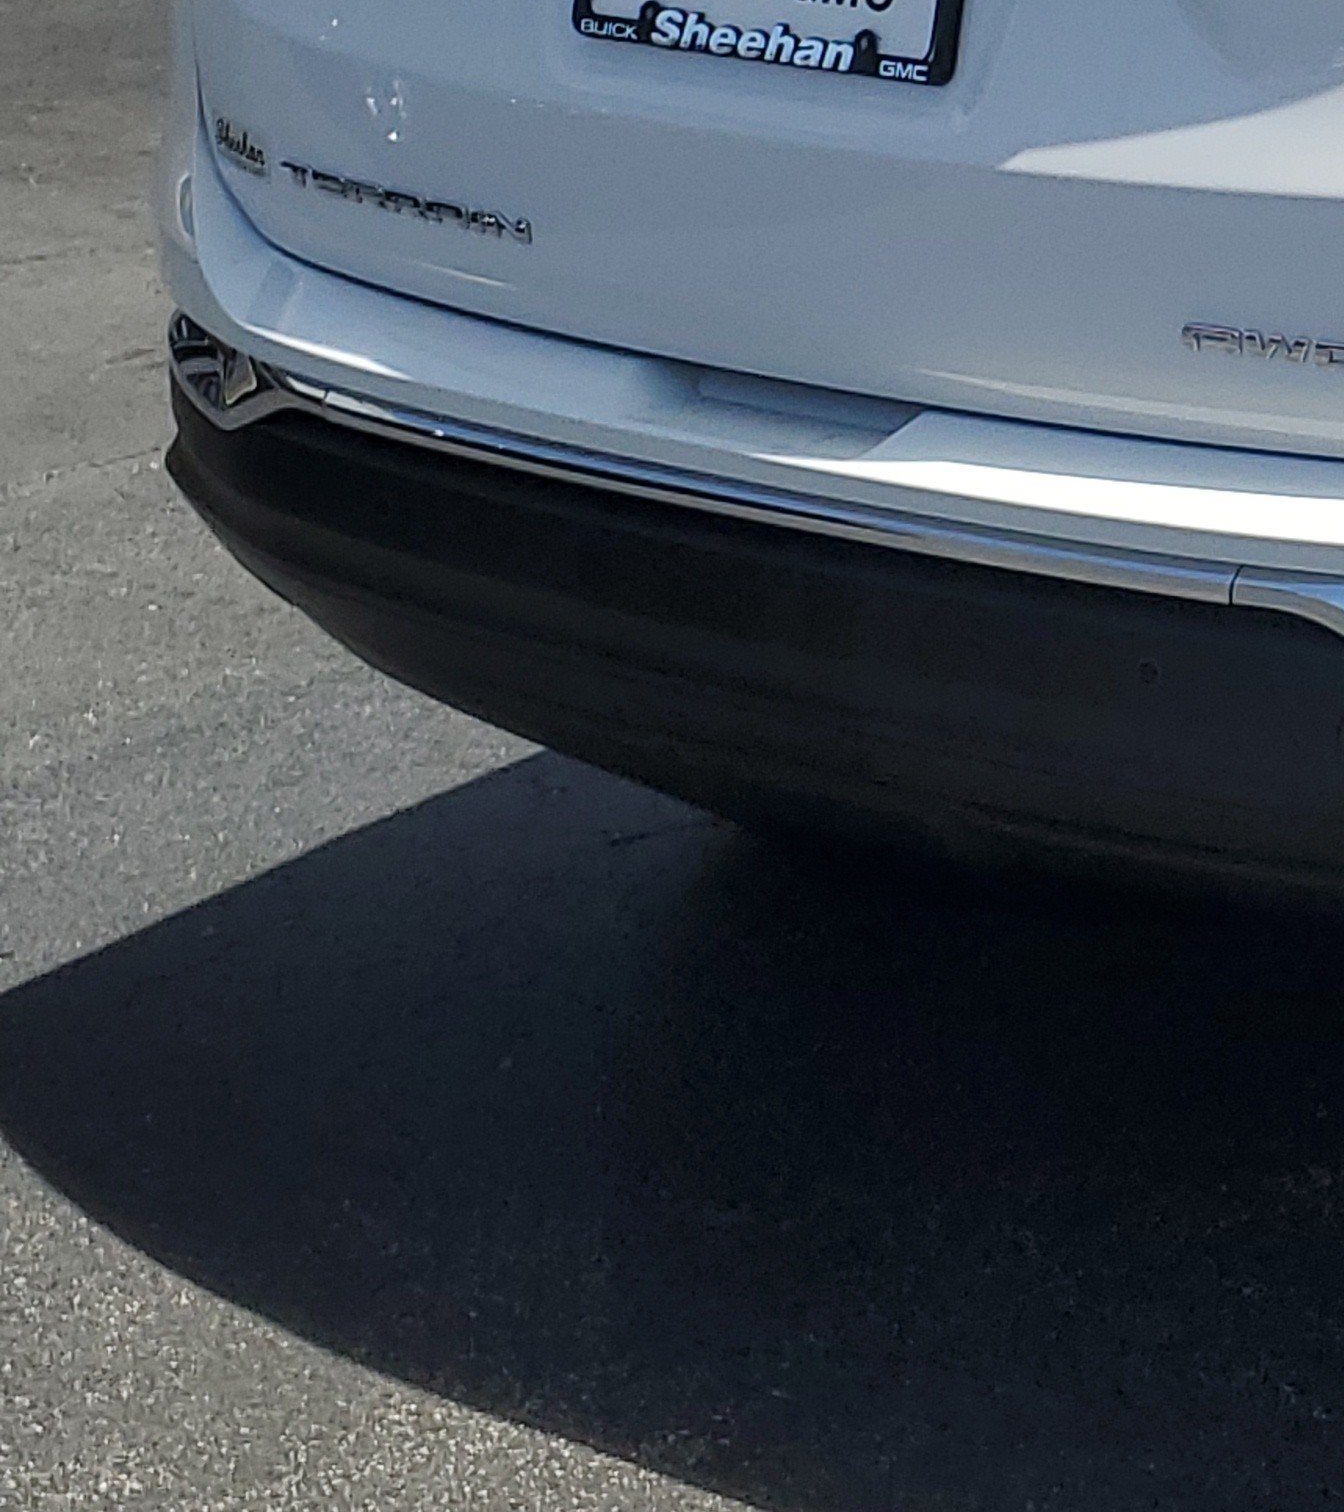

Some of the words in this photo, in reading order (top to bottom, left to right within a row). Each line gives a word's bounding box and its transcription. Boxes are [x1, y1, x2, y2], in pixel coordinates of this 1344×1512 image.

[579, 17, 638, 41] BUICK
[650, 8, 855, 73] Sheehan
[878, 59, 929, 83] GMC
